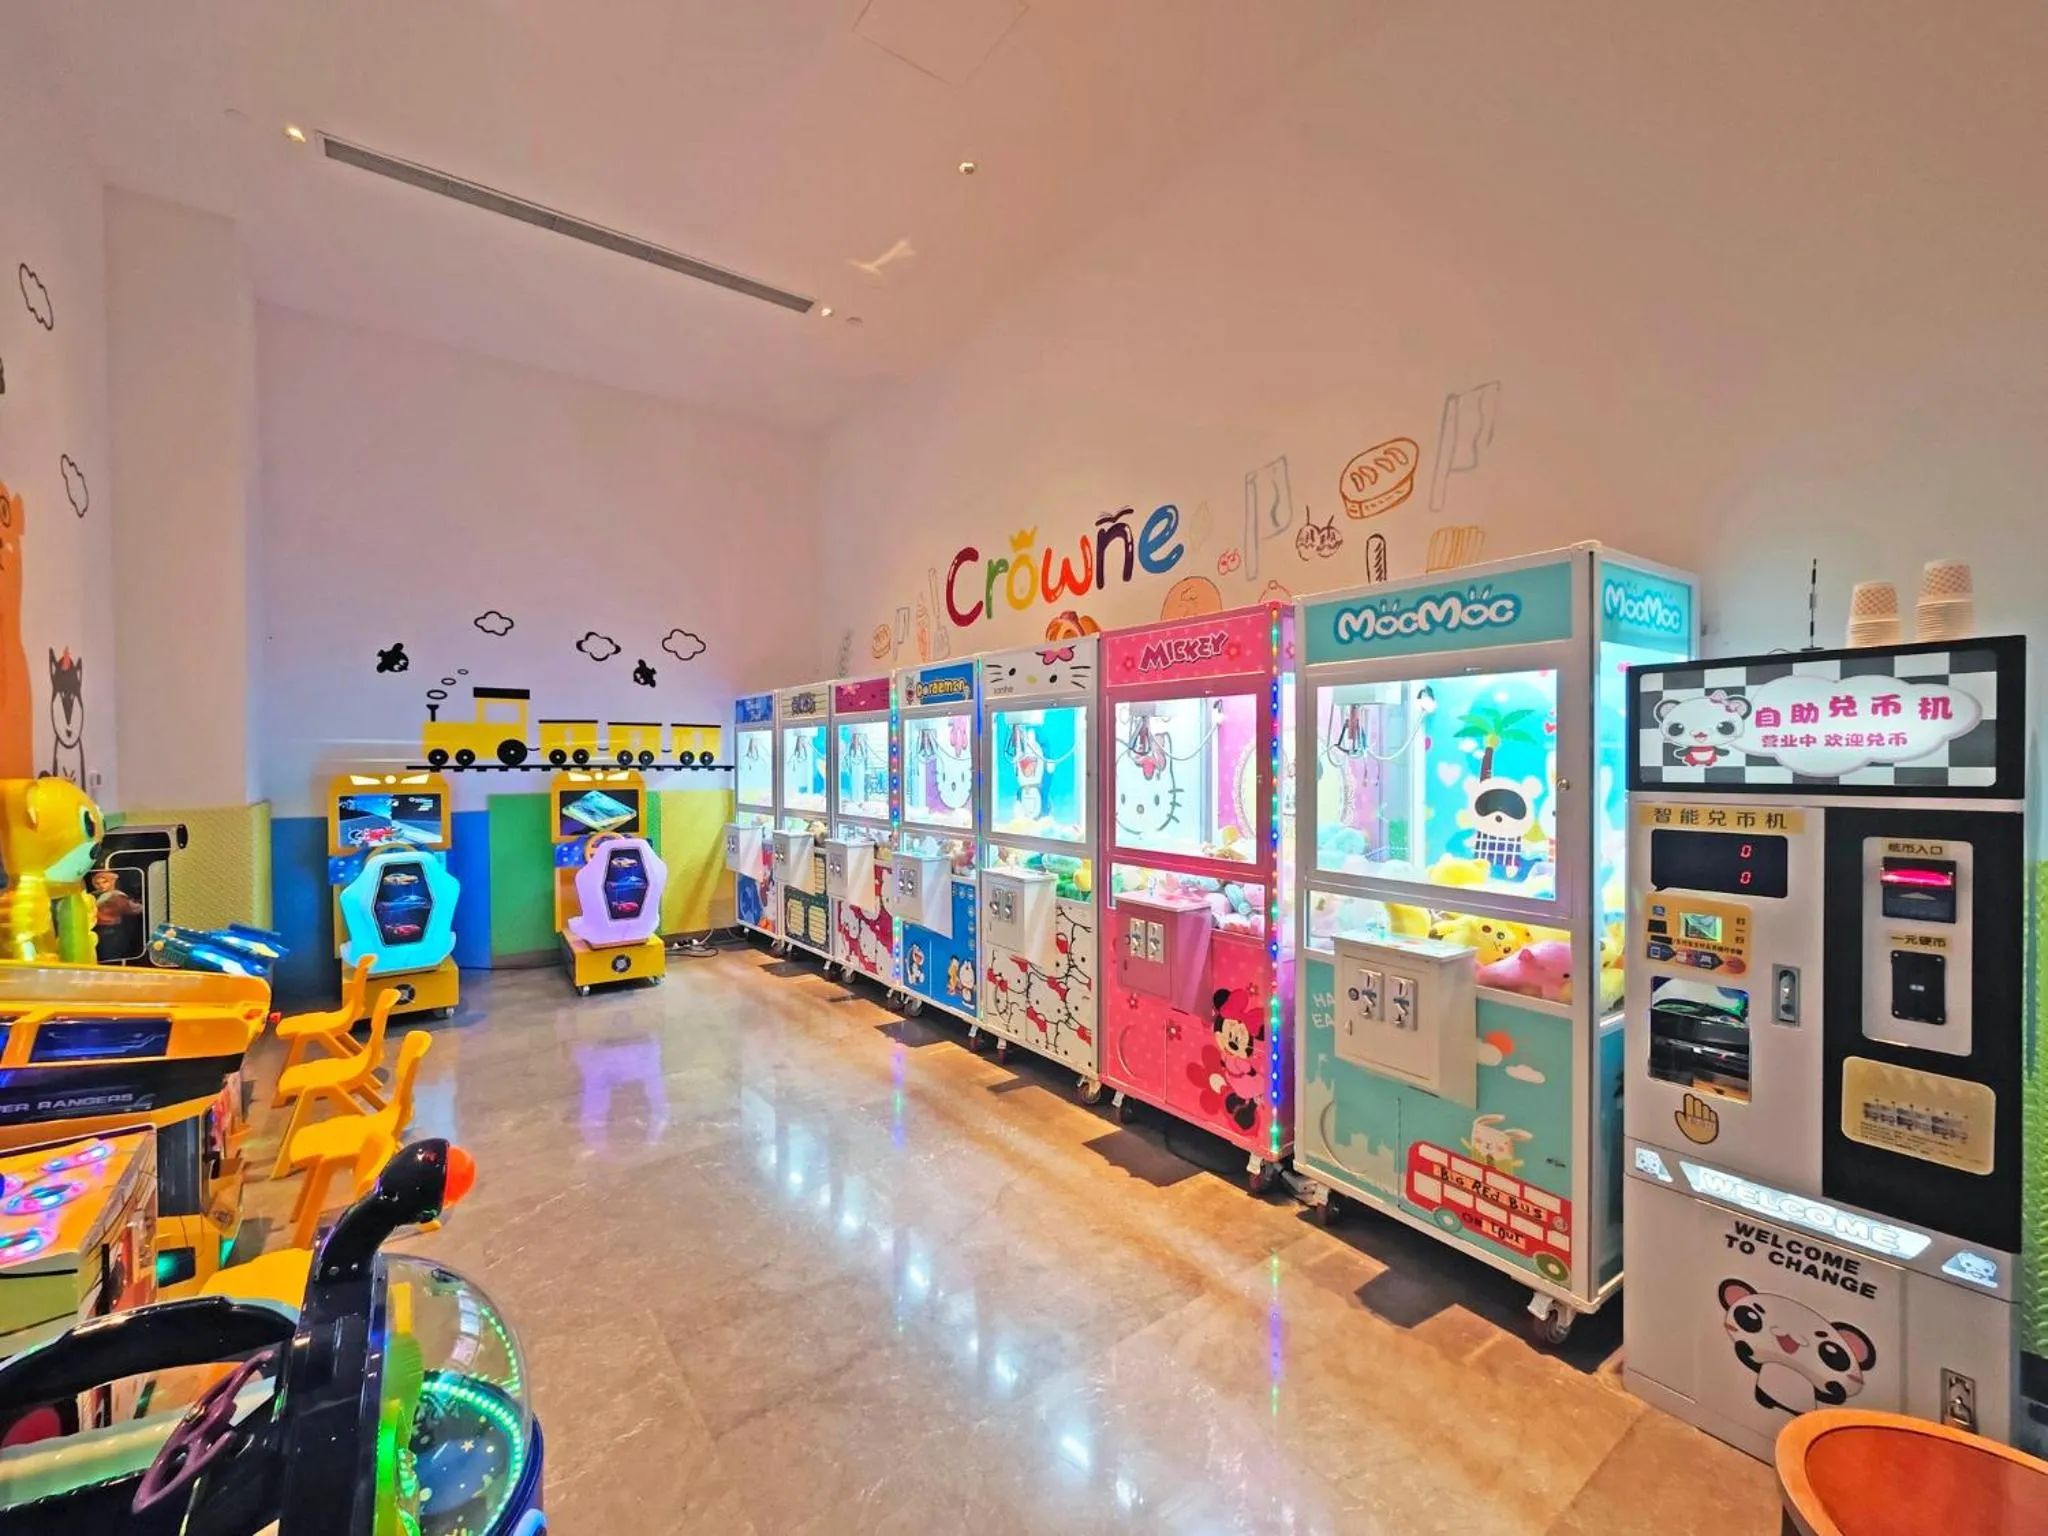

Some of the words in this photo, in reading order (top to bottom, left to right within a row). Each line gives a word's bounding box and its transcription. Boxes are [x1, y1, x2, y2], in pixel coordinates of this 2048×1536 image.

[1138, 631, 1229, 672] MICKEY
[1755, 694, 1954, 728] 自助兑币机
[1761, 734, 1817, 748] 营业中
[1823, 732, 1907, 748] 欢迎兑币
[1653, 807, 1787, 829] 智能兑币机
[1739, 844, 1752, 859] 0
[37, 1093, 133, 1111] RANGERS
[1702, 1171, 1901, 1251] WELCOME
[1734, 1219, 1862, 1276] WELCOME
[1724, 1234, 1756, 1255] TO
[1767, 1251, 1879, 1300] CHANGE
